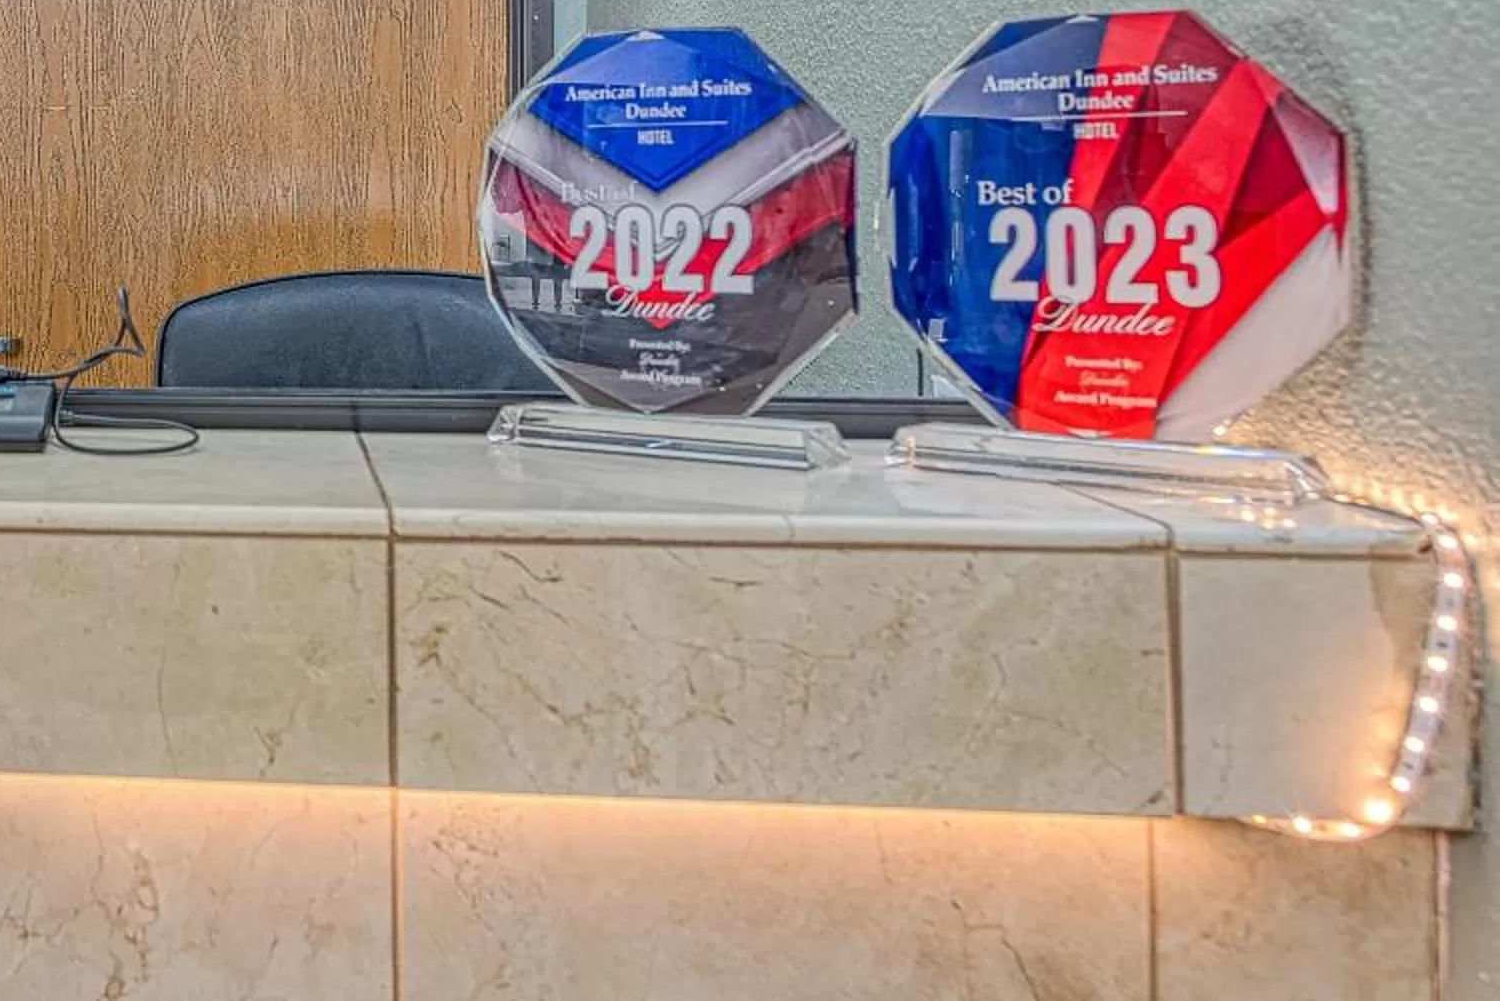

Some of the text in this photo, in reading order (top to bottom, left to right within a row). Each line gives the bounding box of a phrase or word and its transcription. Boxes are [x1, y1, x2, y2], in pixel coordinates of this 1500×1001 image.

[565, 79, 752, 102] American Inn and Suites
[982, 63, 1218, 93] American Inn and Suites
[625, 101, 687, 120] Dundee
[1058, 90, 1135, 112] Dundee
[637, 130, 674, 145] HOTEL
[1073, 122, 1120, 140] HOTEL
[977, 178, 1075, 206] Best of
[569, 203, 754, 295] 2022
[988, 205, 1222, 309] 2023
[601, 285, 717, 322] Dundee
[1032, 295, 1177, 336] Dundee
